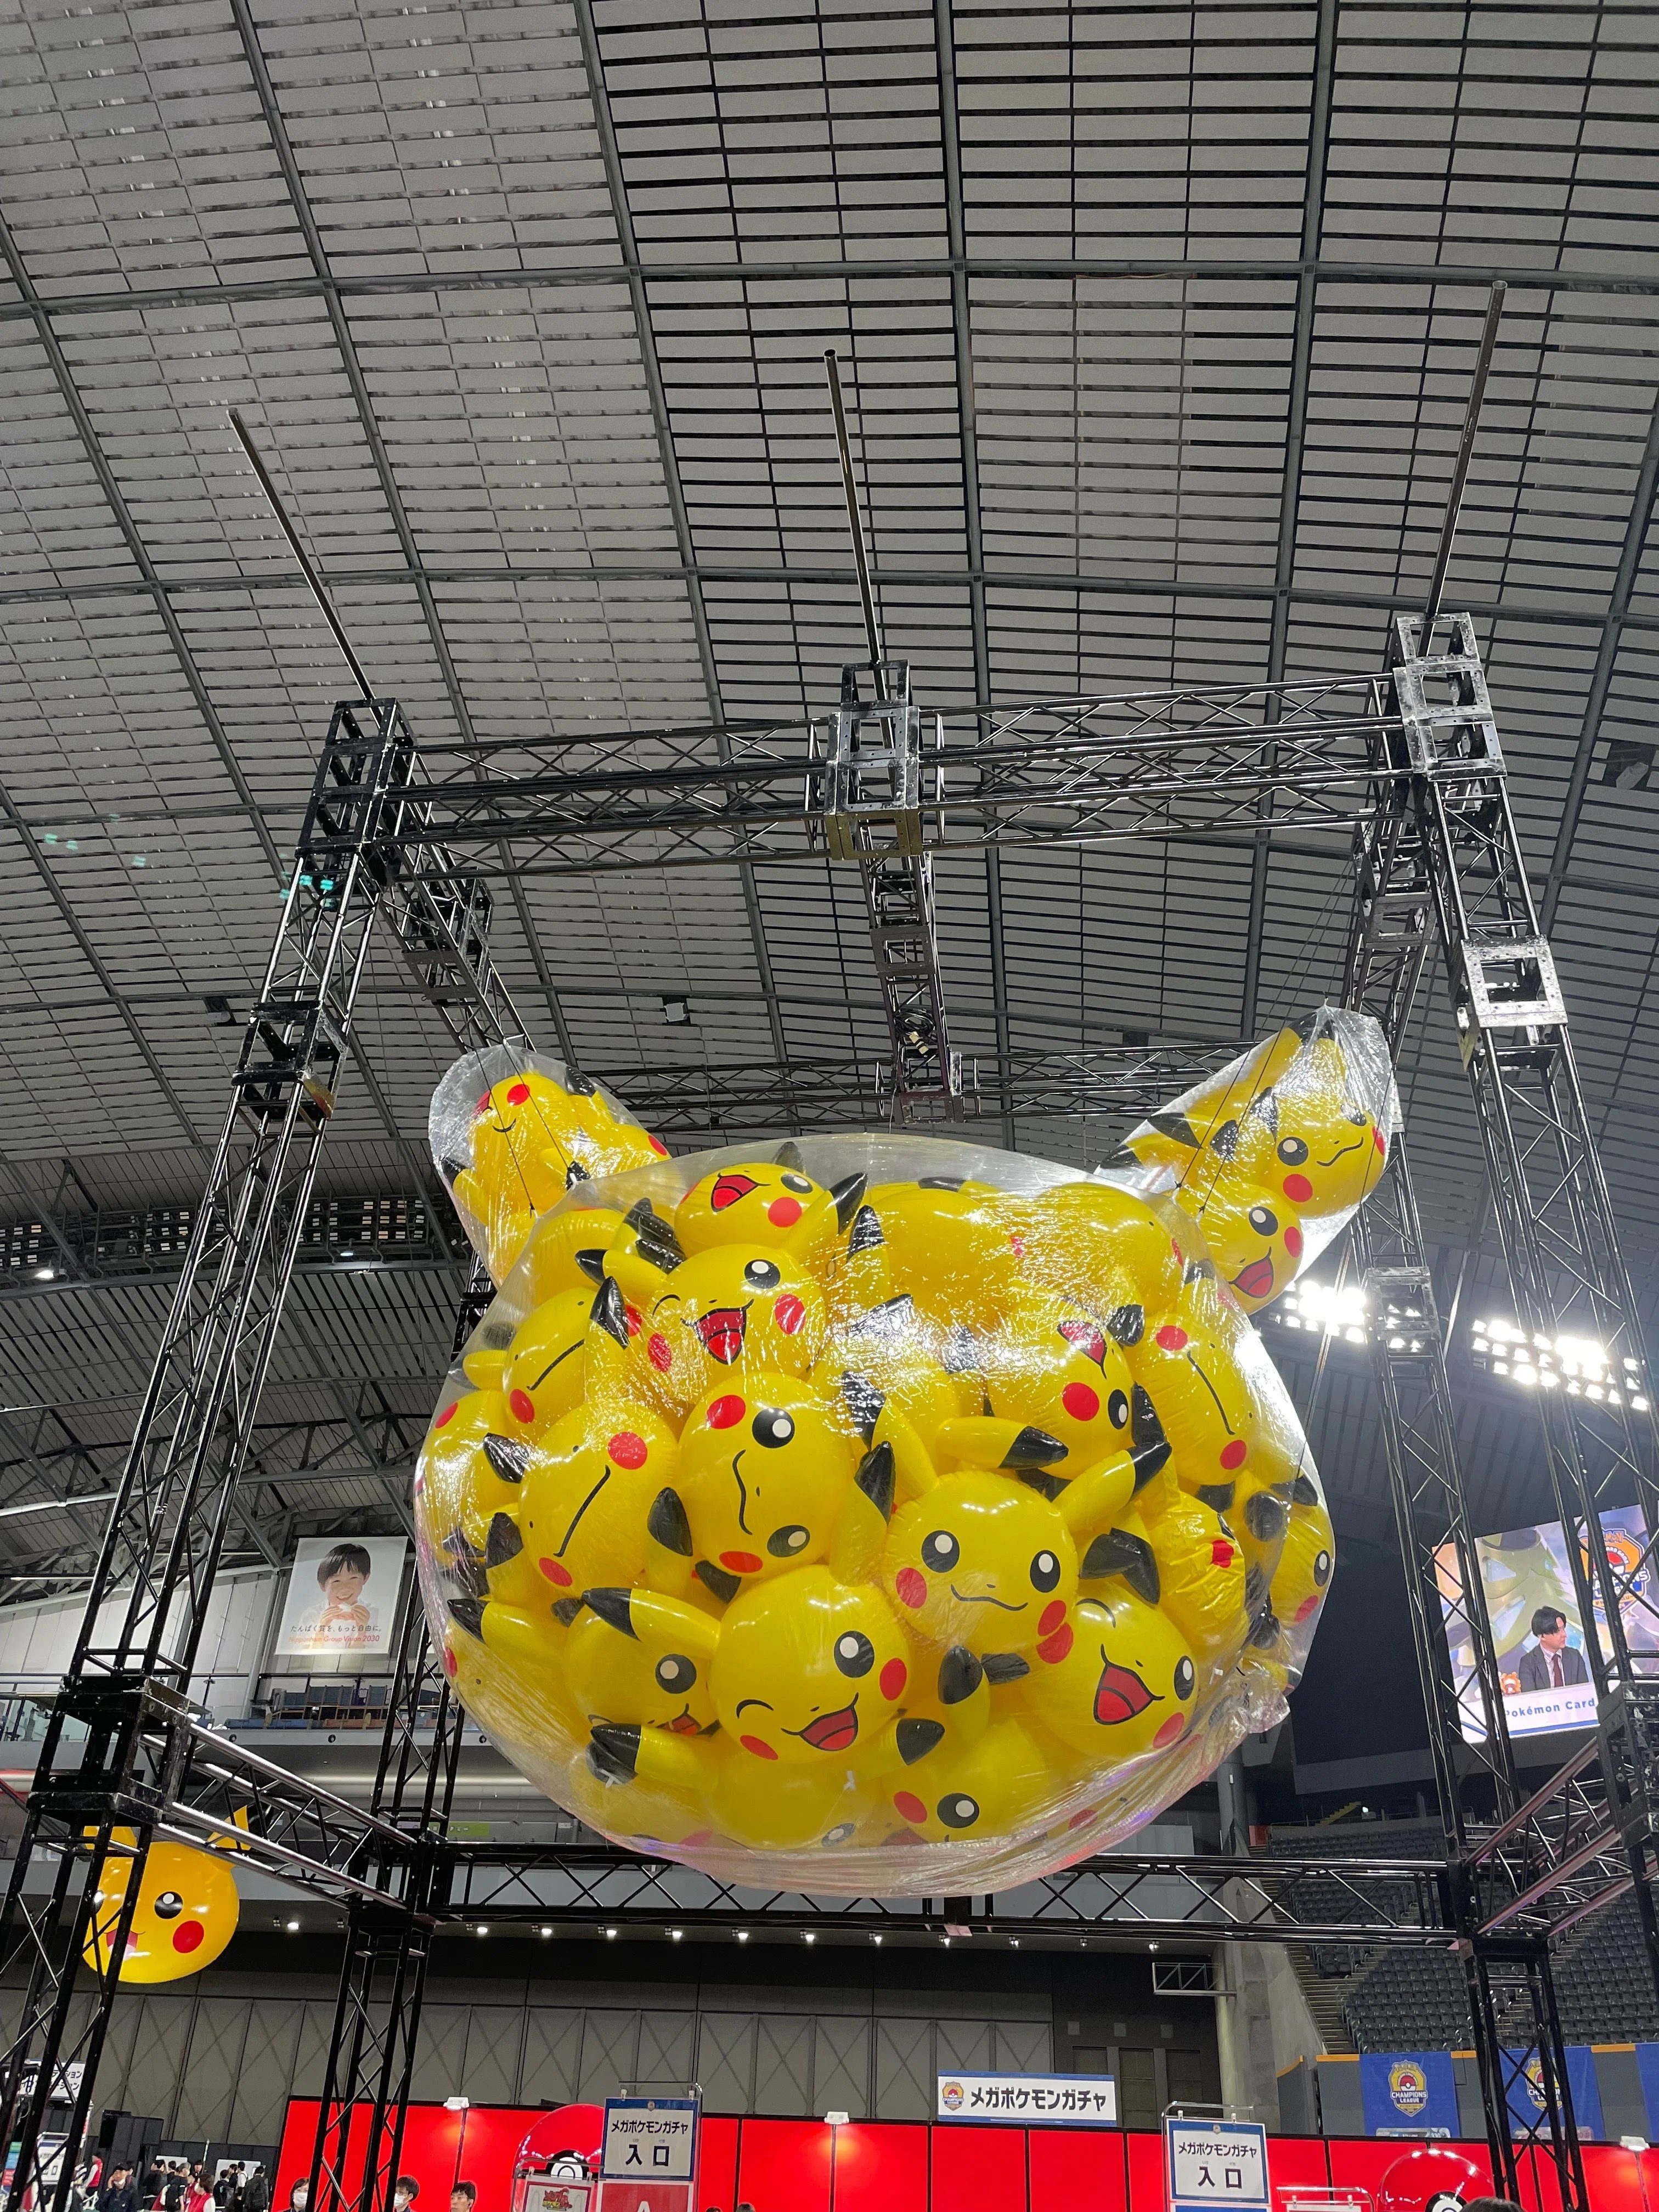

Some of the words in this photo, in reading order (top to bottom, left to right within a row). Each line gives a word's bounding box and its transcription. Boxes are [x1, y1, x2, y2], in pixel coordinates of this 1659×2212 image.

[1565, 1698, 1595, 1709] Card
[970, 2086, 1107, 2112] メガポケモンガチャ
[611, 2120, 689, 2134] メガポケモンガチャ
[625, 2144, 669, 2166] 入口
[1178, 2142, 1257, 2158] メガポケモンガチャ
[1198, 2166, 1242, 2189] 入口
